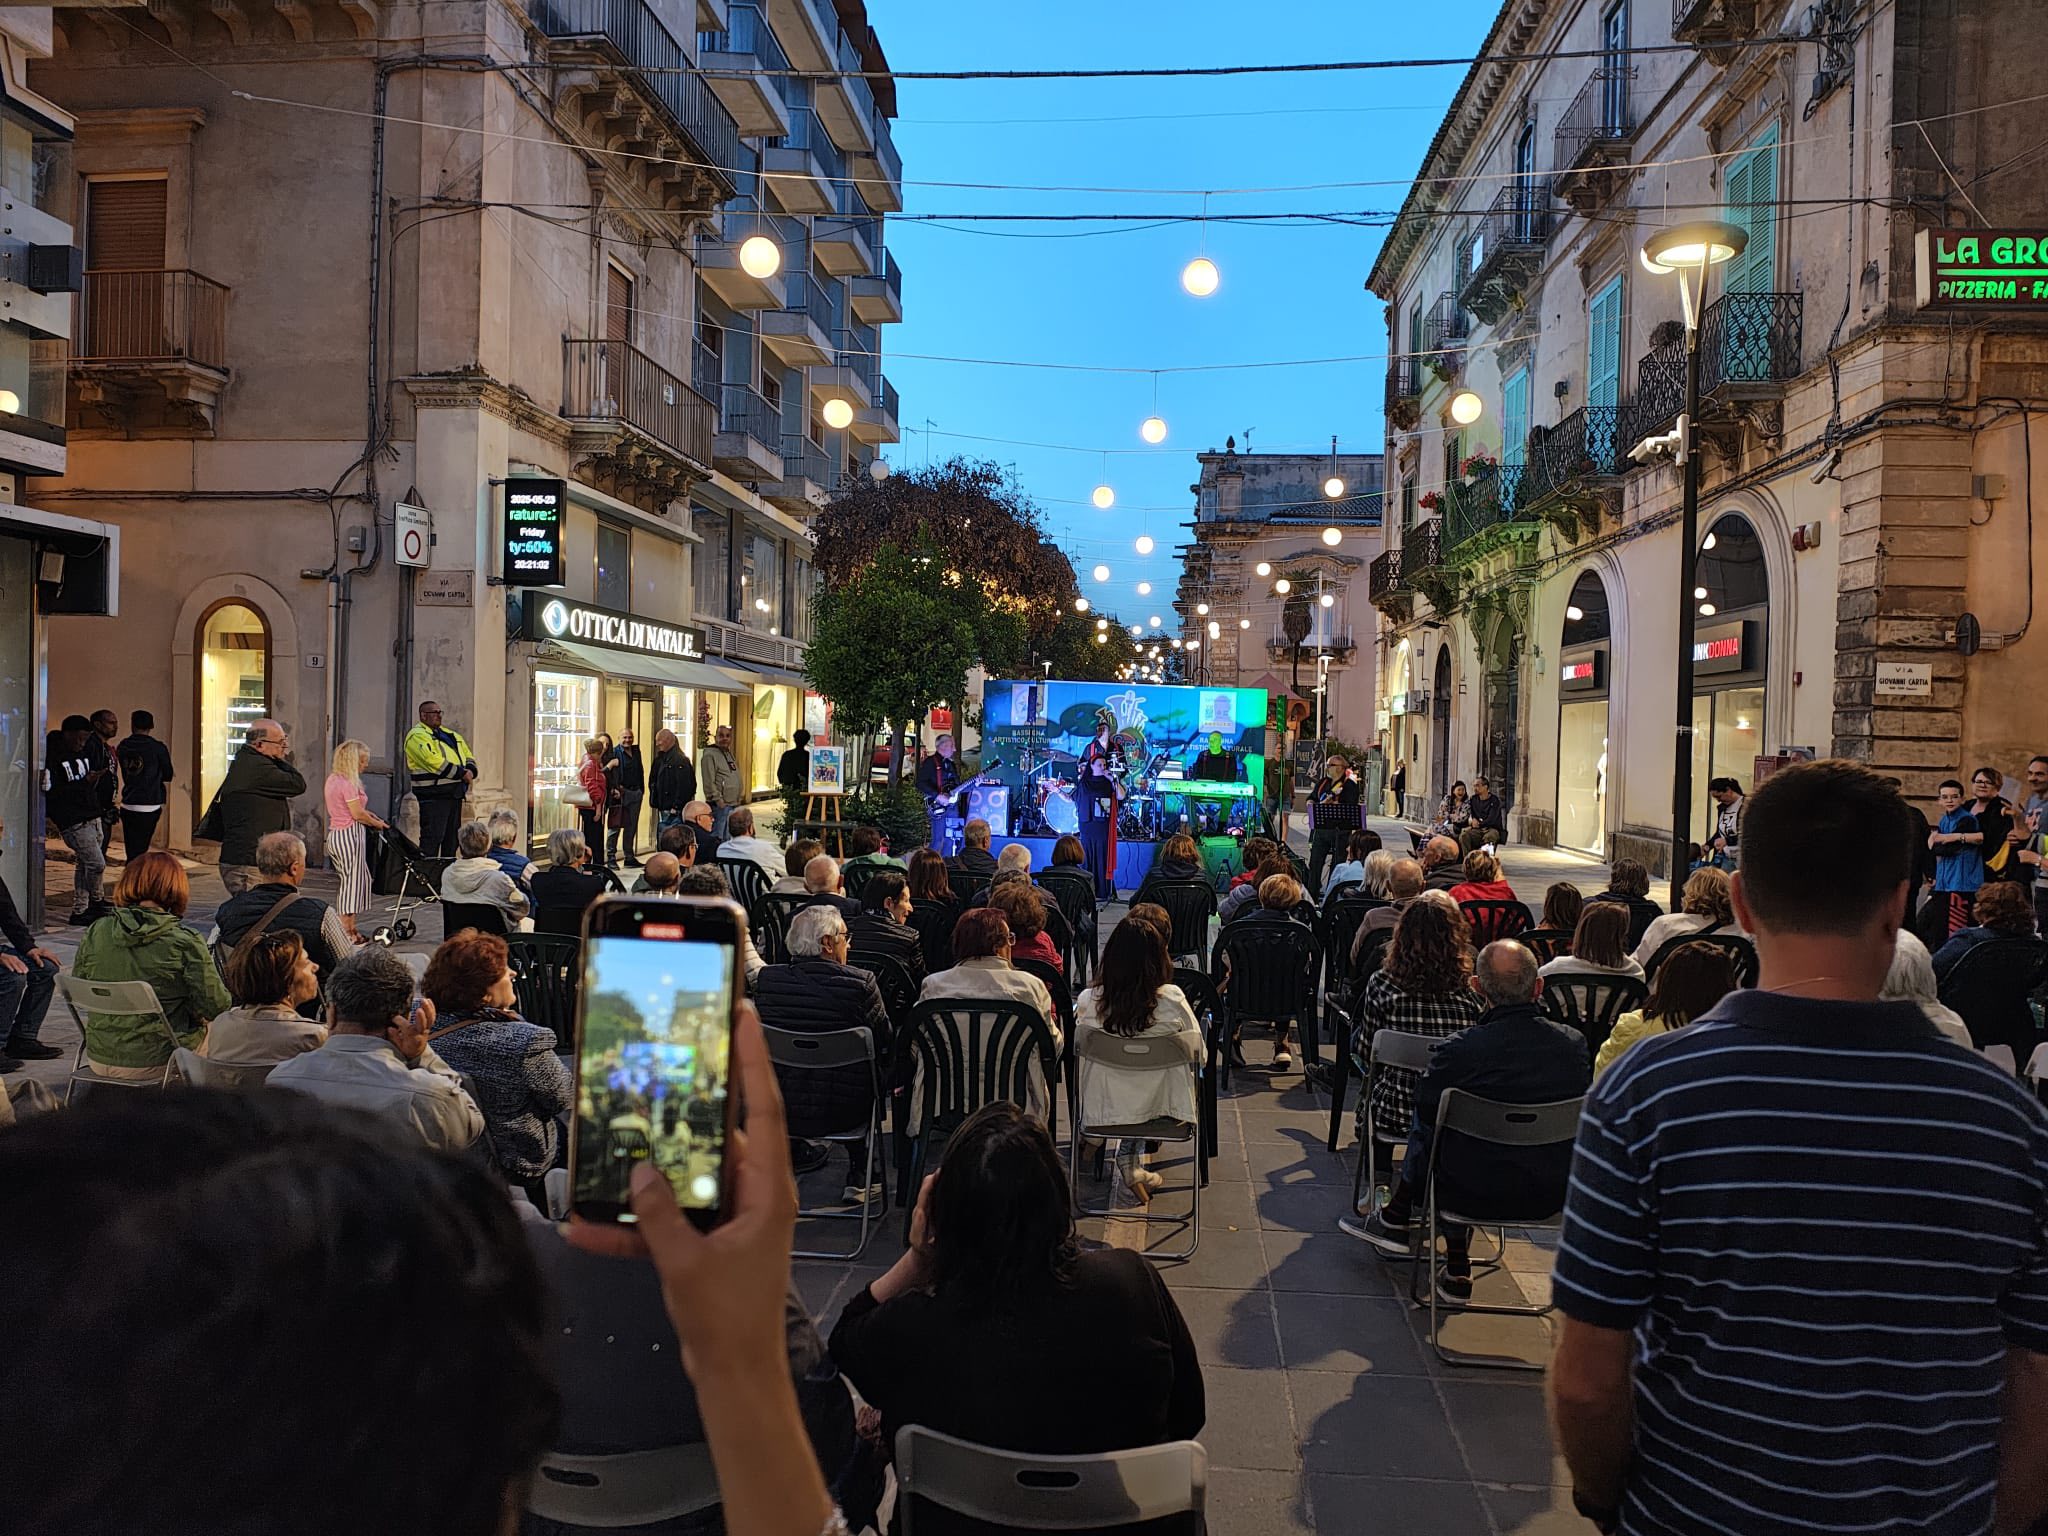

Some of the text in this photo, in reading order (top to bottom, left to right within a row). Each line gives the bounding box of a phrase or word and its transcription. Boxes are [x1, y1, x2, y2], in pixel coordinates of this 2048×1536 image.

[1936, 237, 1980, 264] LA
[1938, 281, 2016, 299] PIZZERIA
[520, 527, 546, 538] Friday
[570, 608, 695, 657] OTTICA DI NATALE
[312, 656, 319, 666] 9
[1878, 677, 1929, 686] GIOVANNI CARTIA
